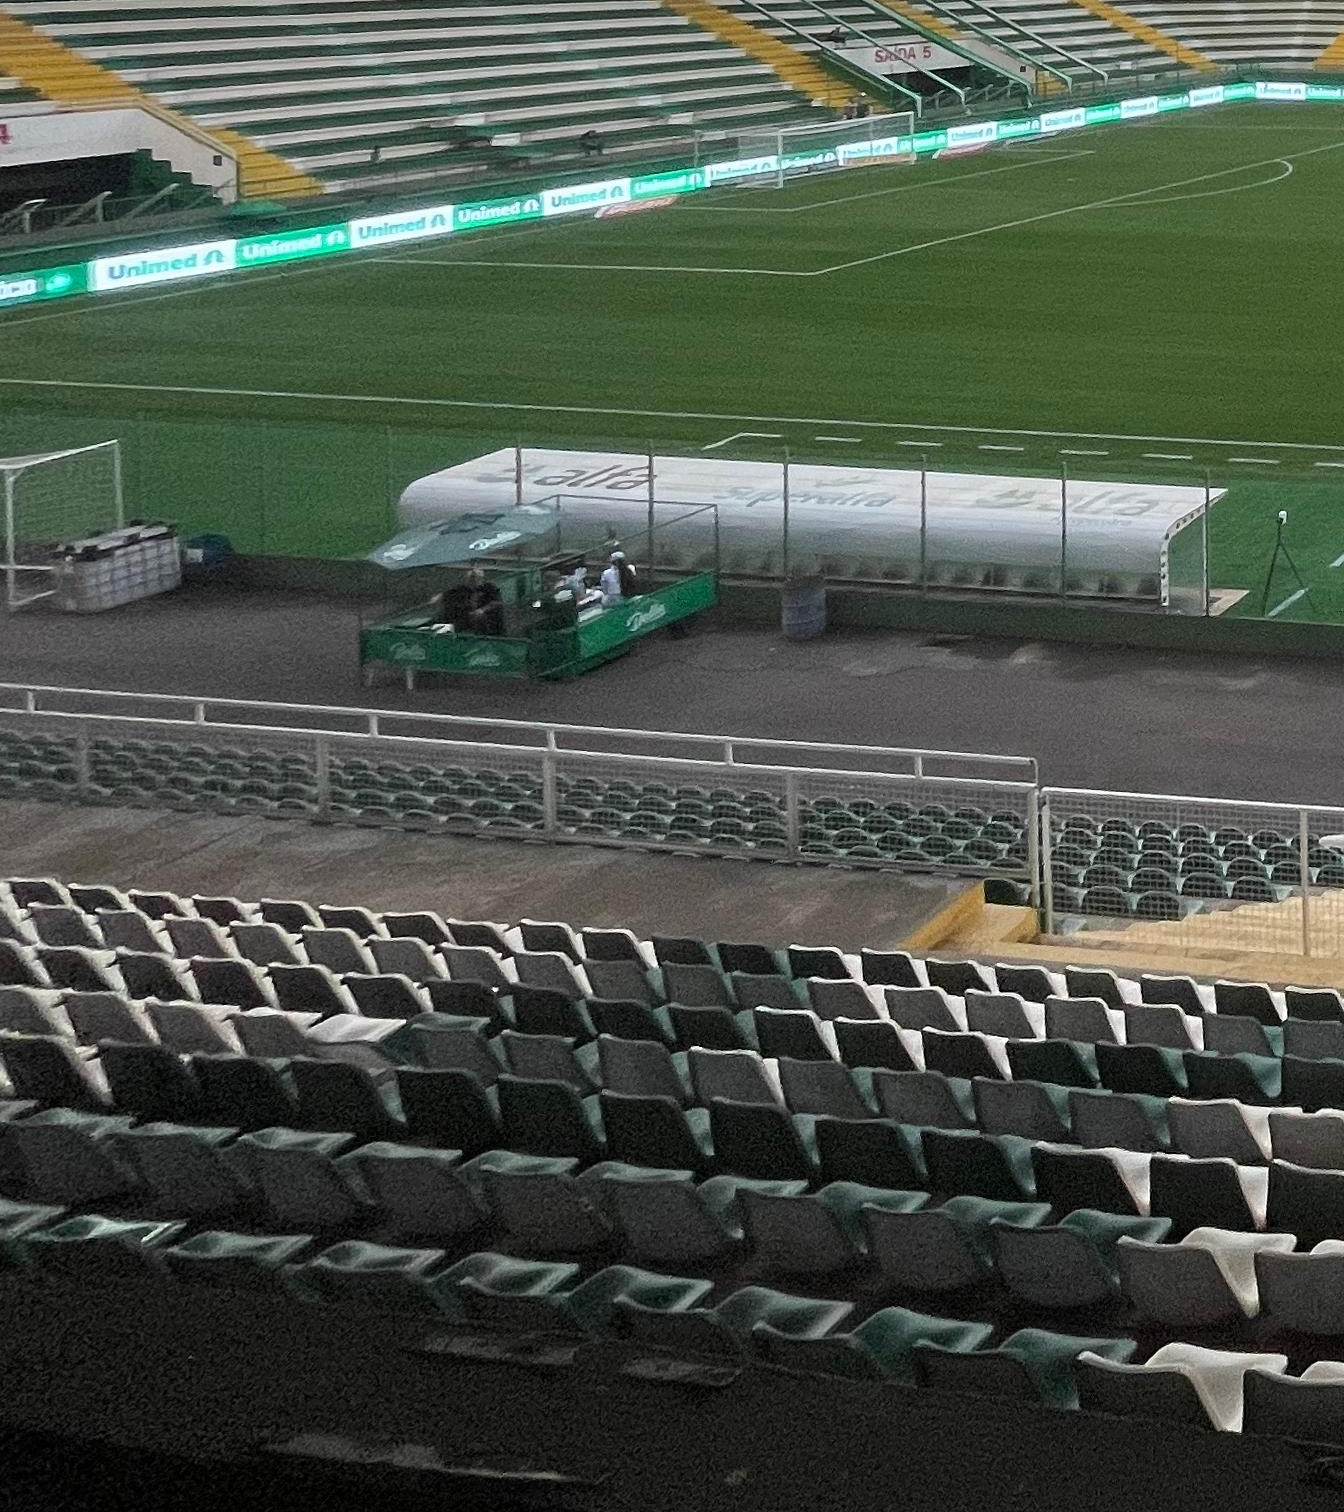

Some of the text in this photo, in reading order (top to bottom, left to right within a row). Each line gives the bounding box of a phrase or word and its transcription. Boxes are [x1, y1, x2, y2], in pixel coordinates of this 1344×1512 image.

[923, 46, 932, 58] 5
[551, 187, 606, 207] Unimed
[458, 201, 520, 223] Unimed
